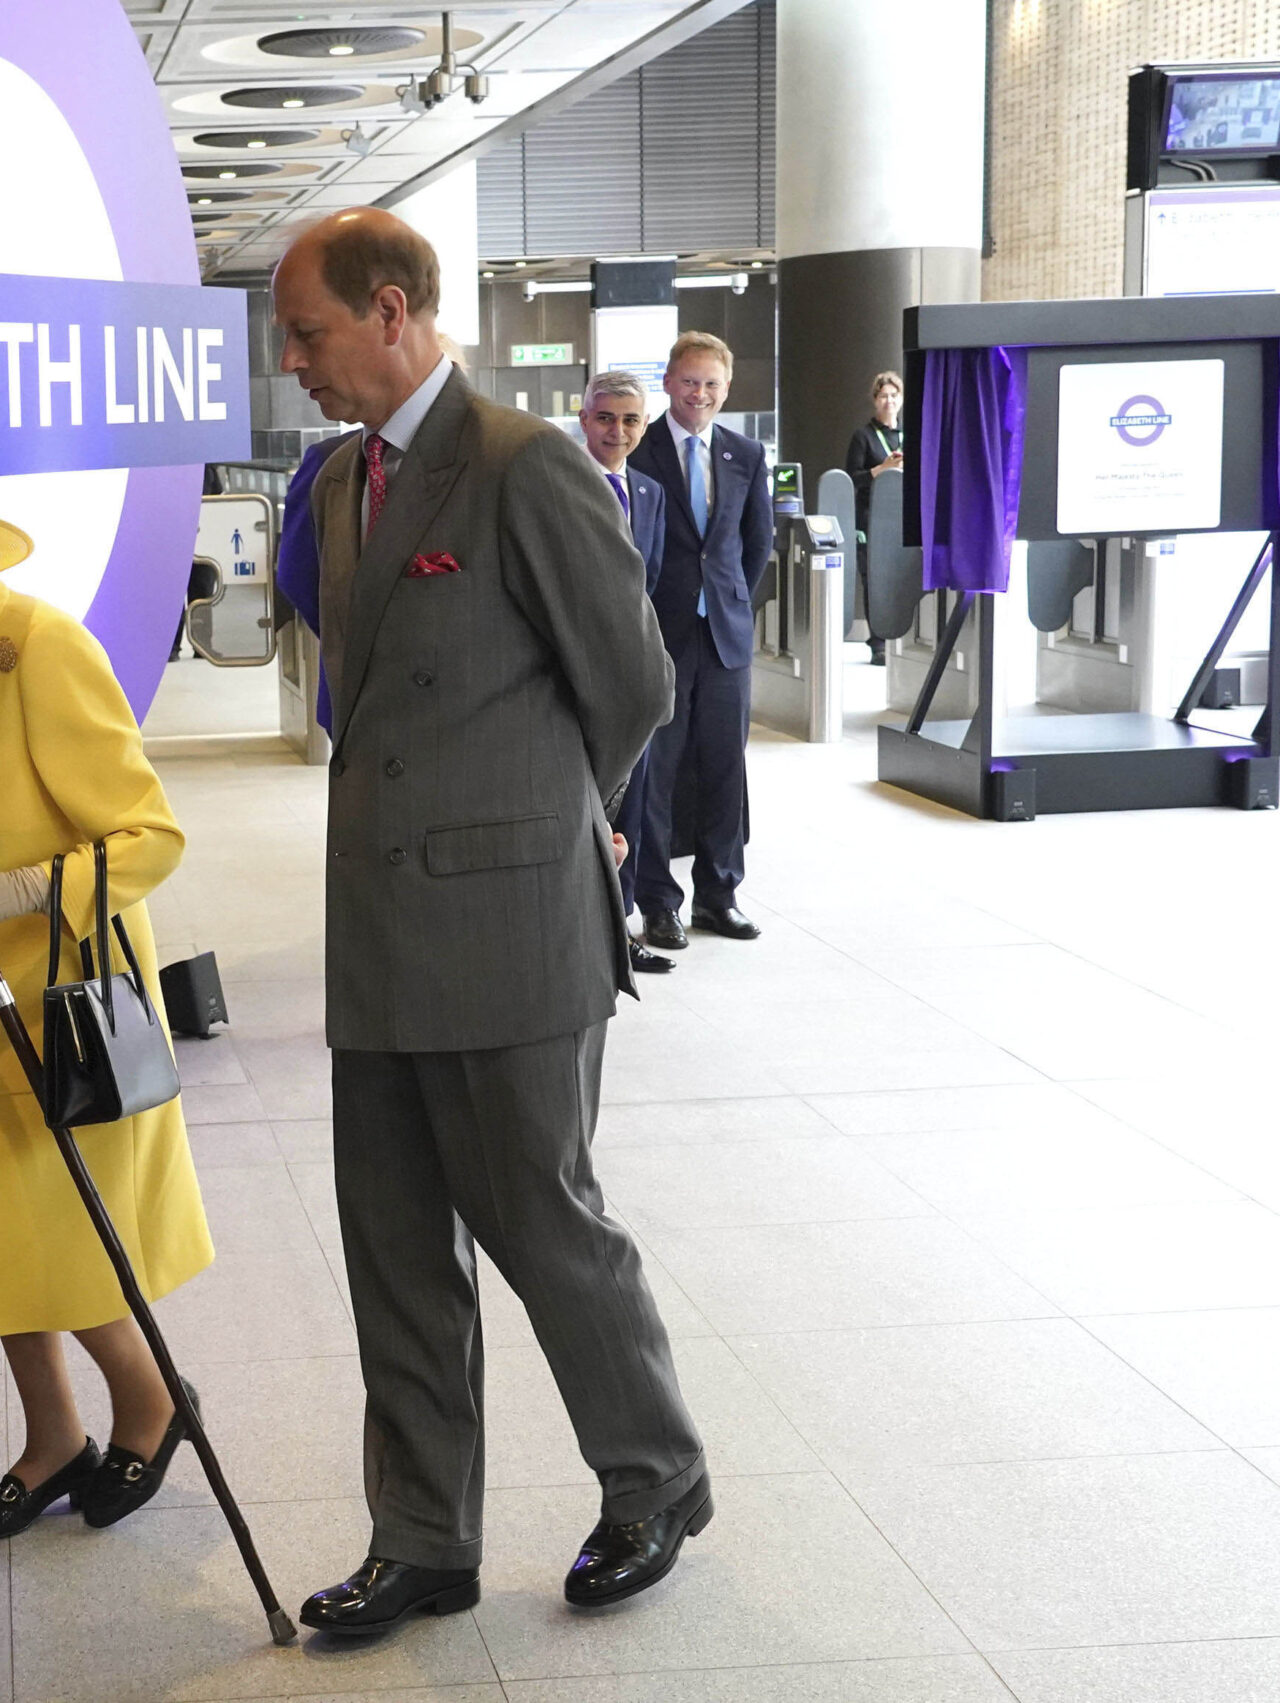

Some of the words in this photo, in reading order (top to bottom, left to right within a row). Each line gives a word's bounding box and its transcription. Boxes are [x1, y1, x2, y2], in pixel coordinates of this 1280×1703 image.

[104, 325, 227, 424] LINE
[1111, 417, 1152, 426] ELIZABETH
[1153, 416, 1170, 424] LINE
